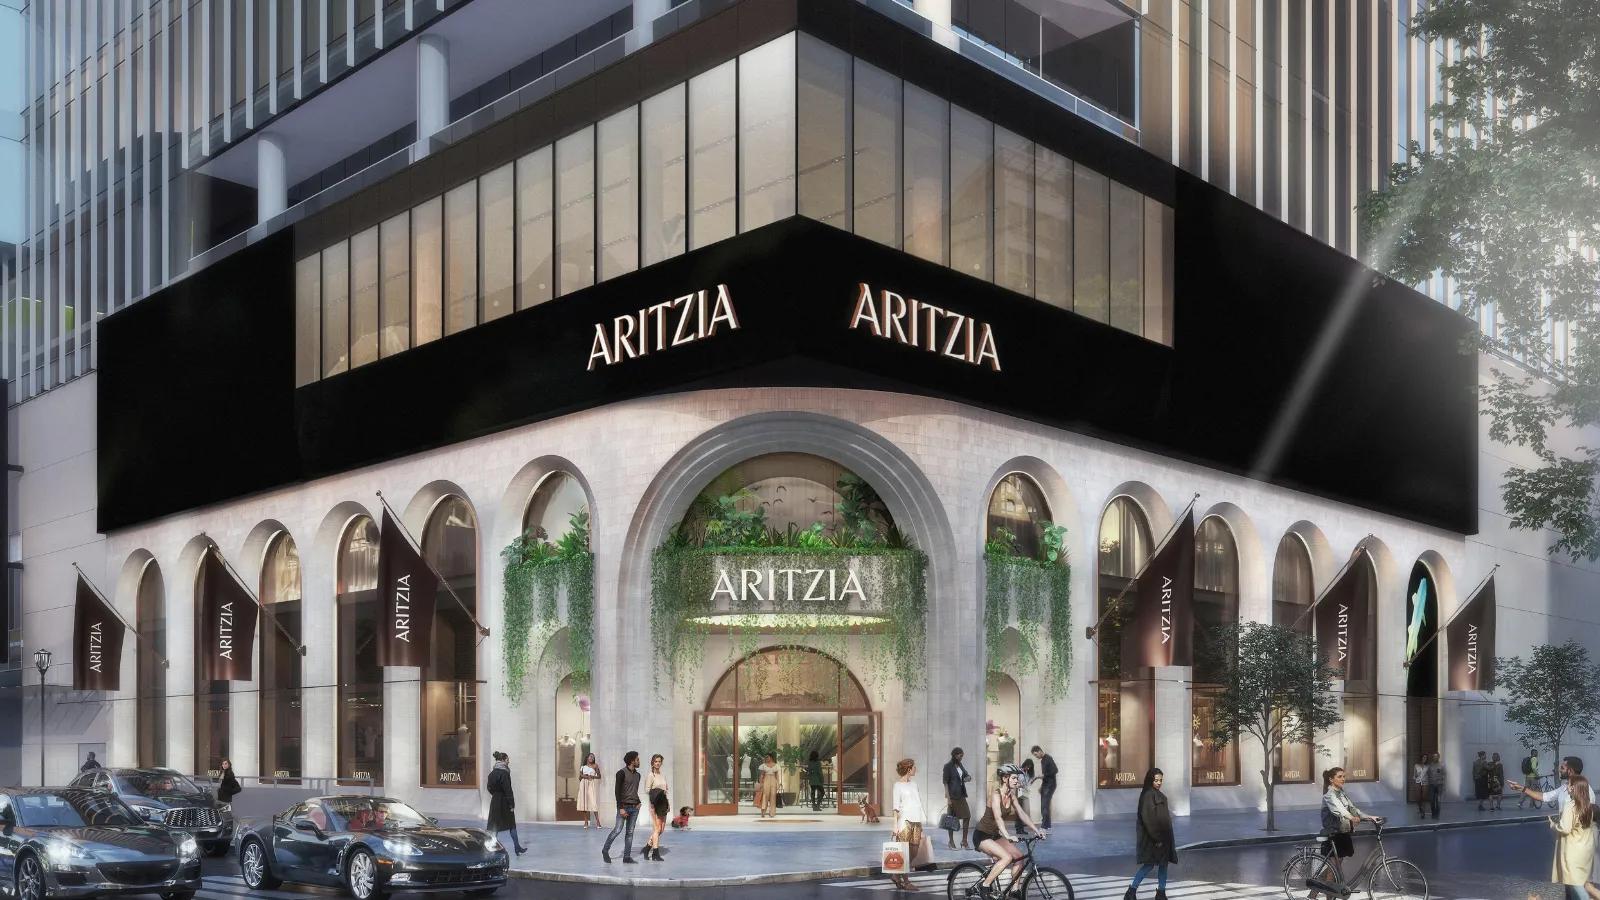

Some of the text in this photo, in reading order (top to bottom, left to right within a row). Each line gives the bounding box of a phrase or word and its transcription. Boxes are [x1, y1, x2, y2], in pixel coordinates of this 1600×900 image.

[586, 283, 742, 371] ARITZIA
[848, 282, 1001, 372] ARITZIA
[394, 574, 411, 643] ARITZIA
[709, 569, 867, 601] ARITZIA
[1161, 576, 1173, 645] ARITZIA
[89, 622, 102, 673] ARITZIA
[218, 602, 233, 660] ARITZIA
[1337, 603, 1349, 662] ARITZIA
[1467, 623, 1478, 675] ARITZIA
[440, 772, 462, 781] ARITZIA
[1115, 772, 1136, 781] ARITZIA
